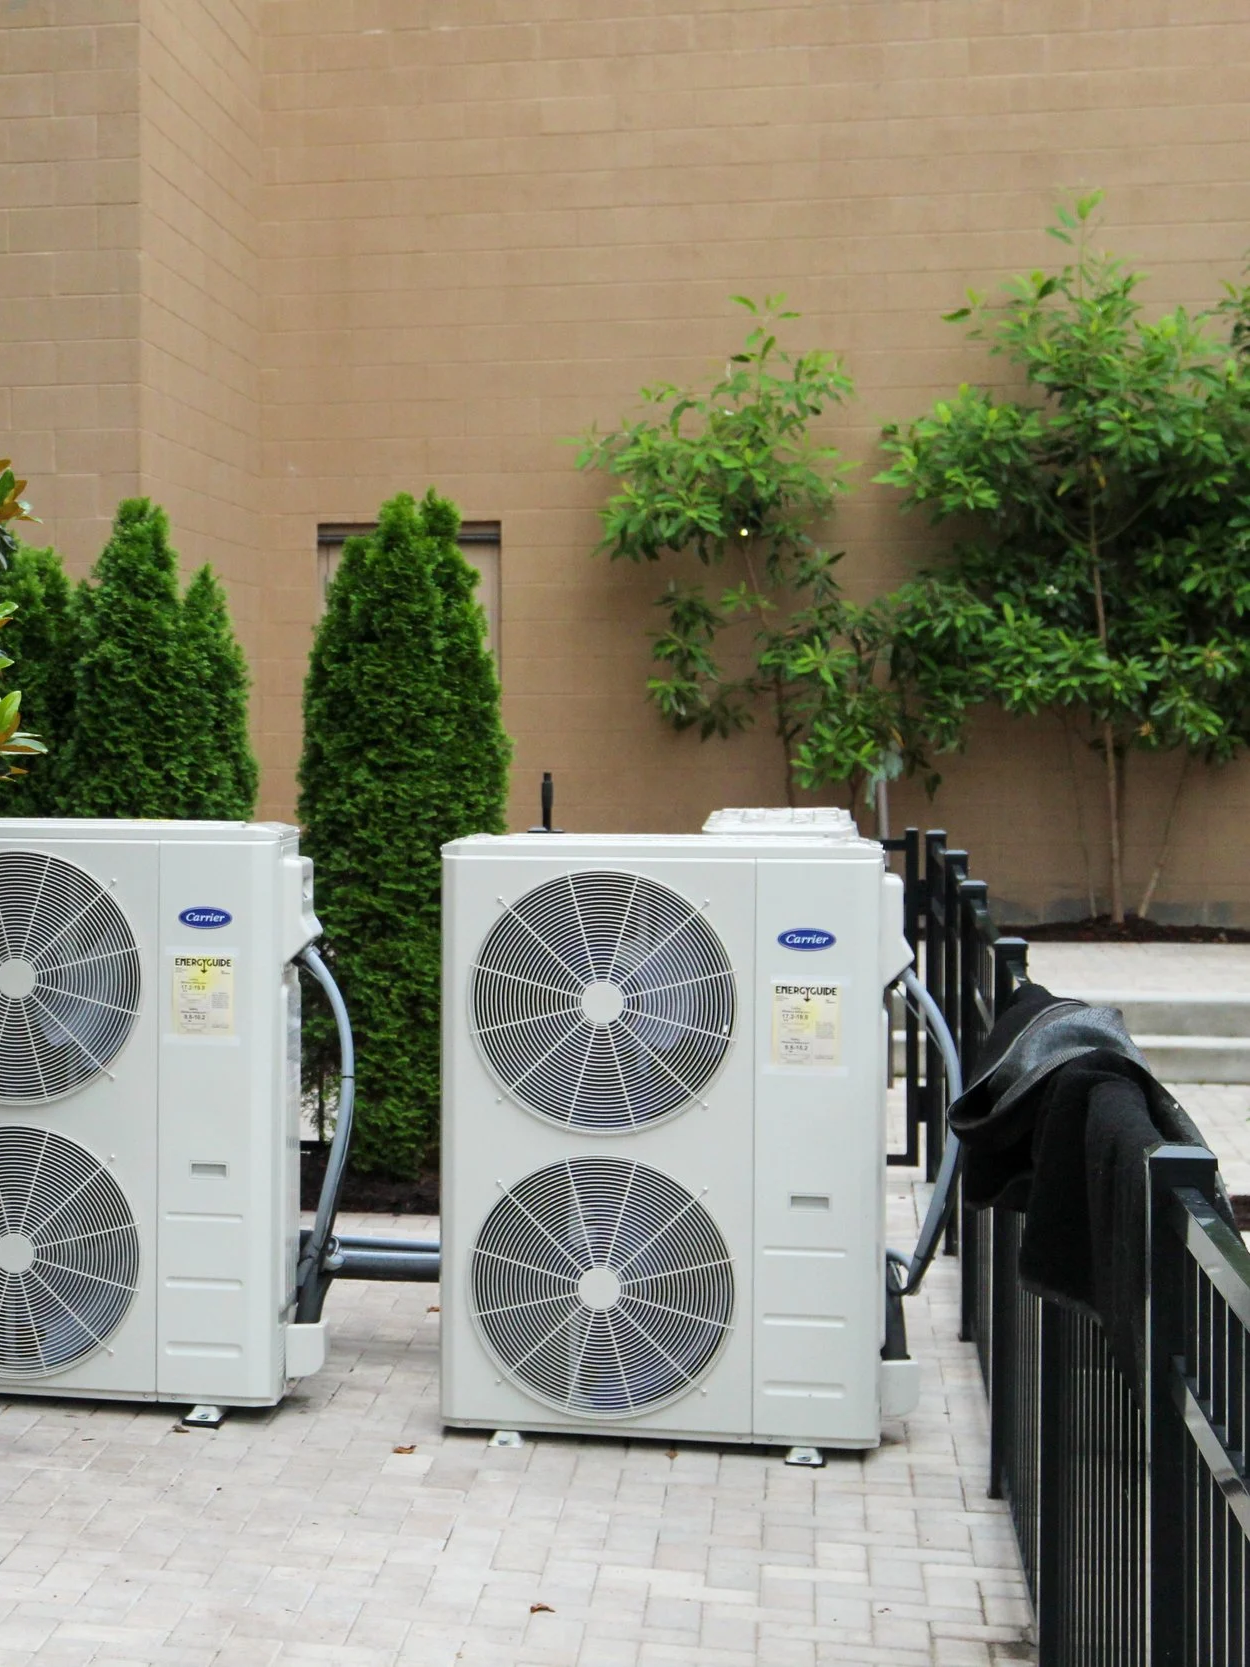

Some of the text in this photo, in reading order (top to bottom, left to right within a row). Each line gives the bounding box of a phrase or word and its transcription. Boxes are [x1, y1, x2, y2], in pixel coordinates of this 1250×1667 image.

[185, 912, 225, 922] Carrier
[785, 934, 829, 944] Carrier
[175, 957, 232, 968] ENERGYGUIDE
[775, 985, 838, 997] ENERGYGUIDE
